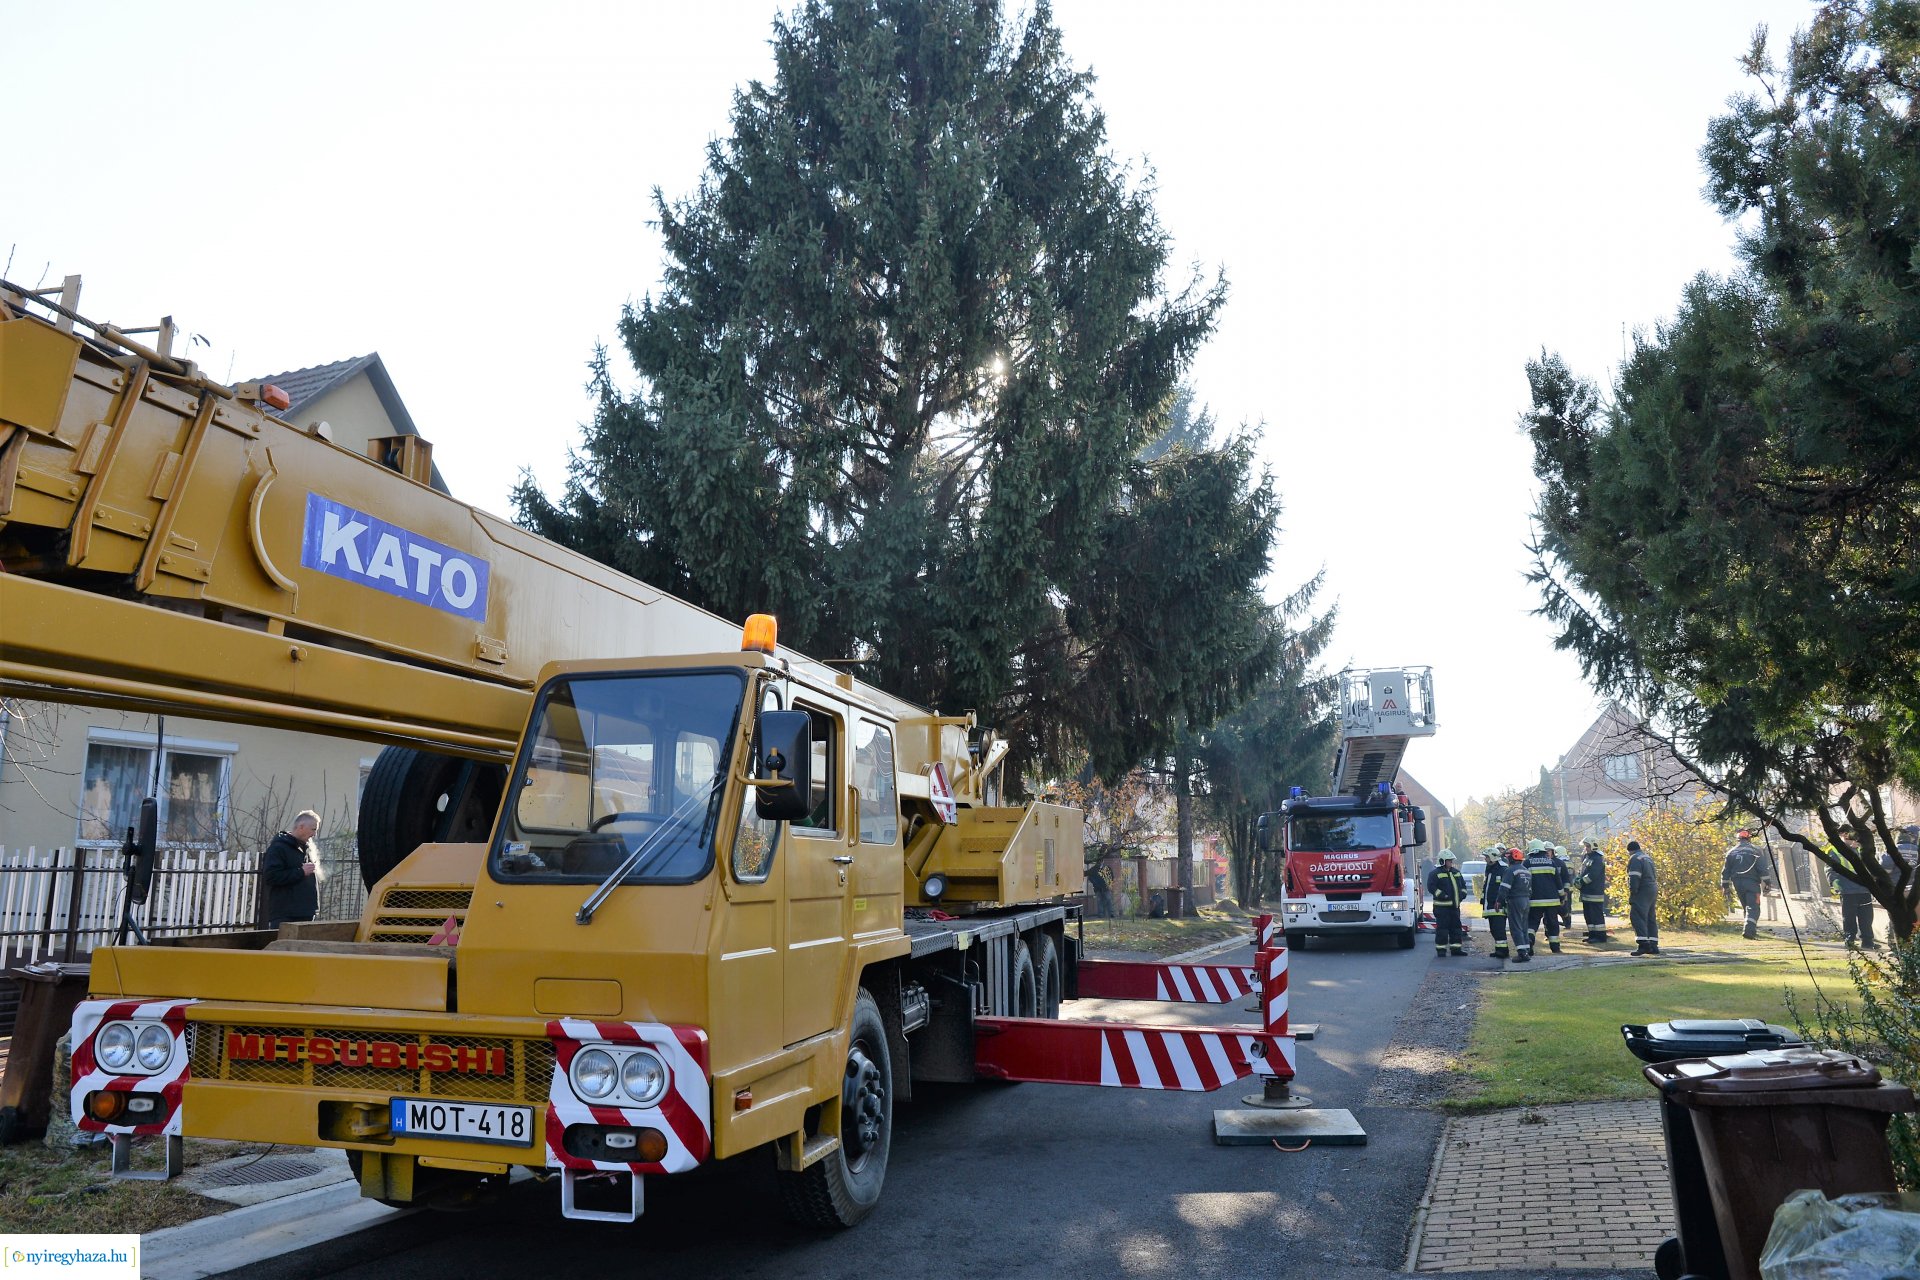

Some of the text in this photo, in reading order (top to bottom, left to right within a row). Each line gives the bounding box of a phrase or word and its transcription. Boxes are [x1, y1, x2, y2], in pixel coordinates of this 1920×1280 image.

[321, 511, 477, 609] KATO
[1324, 874, 1361, 882] IVECO
[228, 1033, 505, 1075] MITSUBISHI
[395, 1118, 403, 1127] H
[411, 1104, 524, 1138] MOT-418
